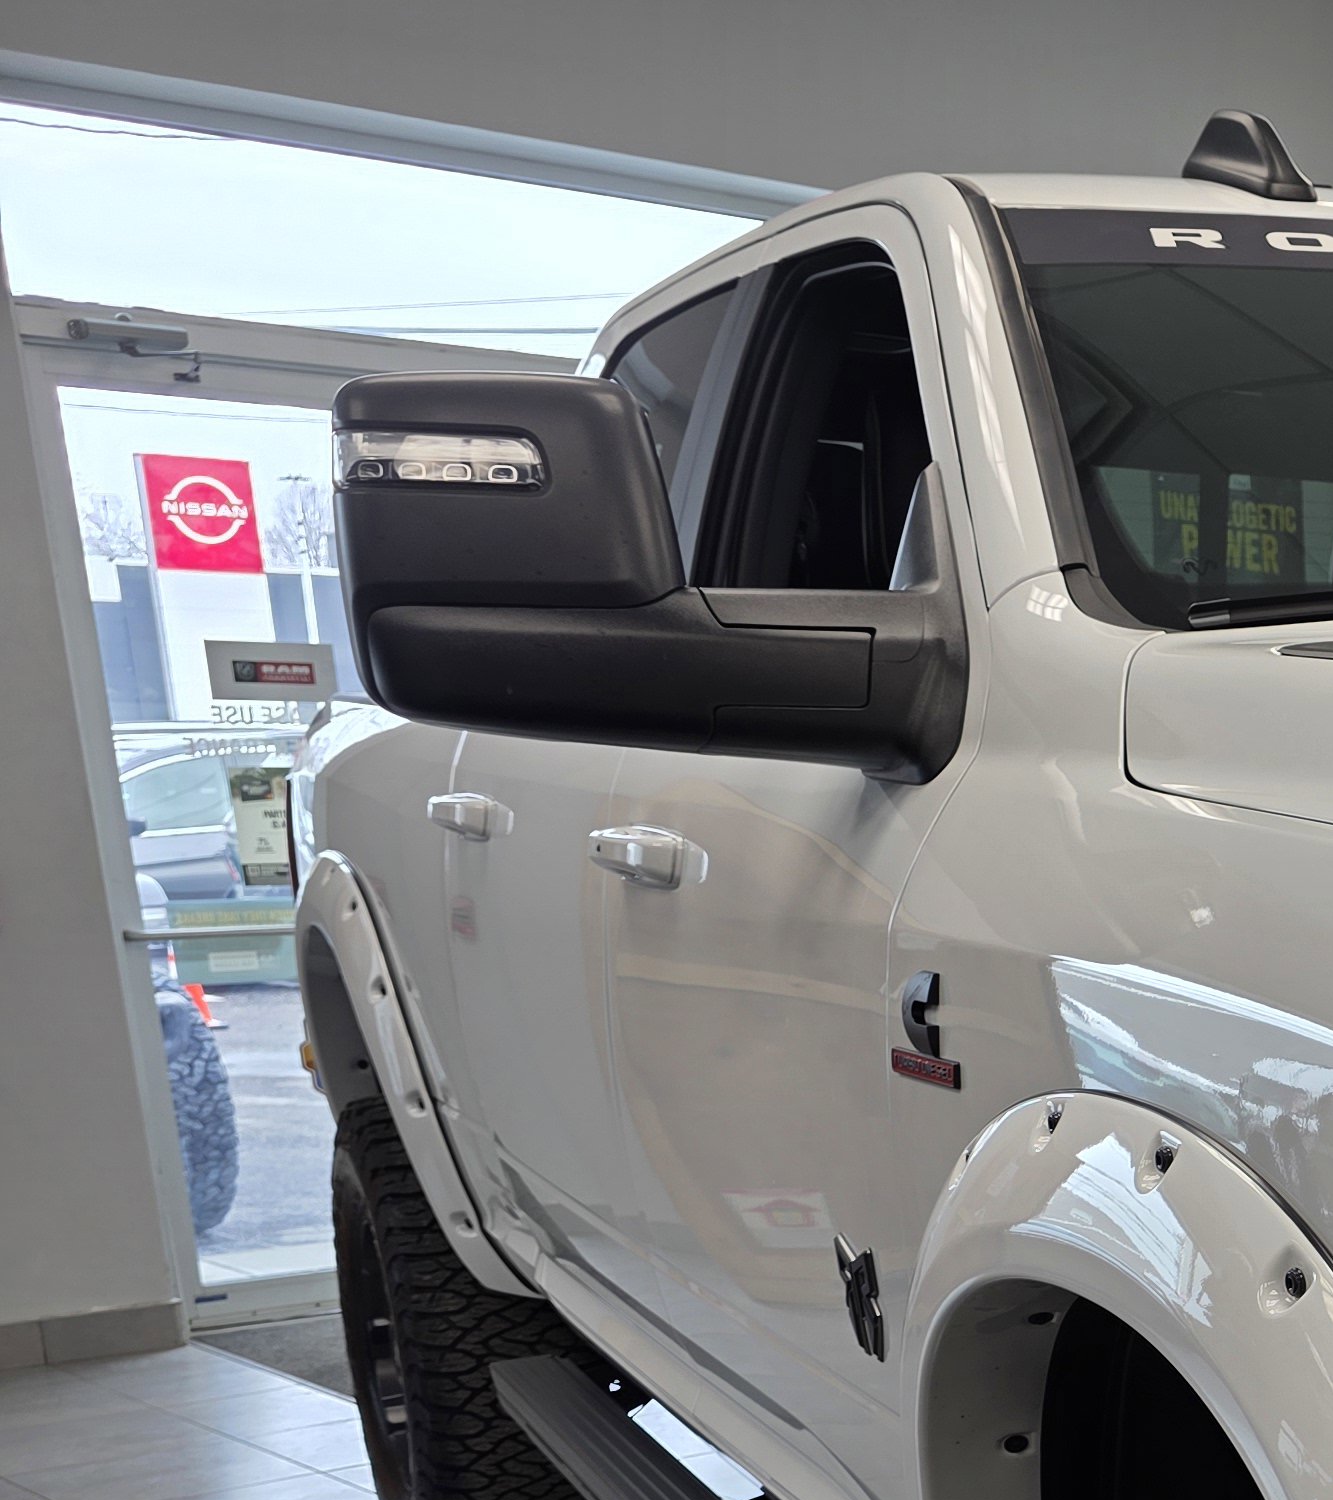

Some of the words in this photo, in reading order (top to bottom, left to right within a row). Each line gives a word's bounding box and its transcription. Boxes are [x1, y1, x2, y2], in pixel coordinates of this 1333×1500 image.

[161, 500, 249, 519] NISSAN
[1159, 489, 1297, 534] UNAOGETIC
[1180, 522, 1280, 577] PWER
[260, 664, 311, 675] RAM
